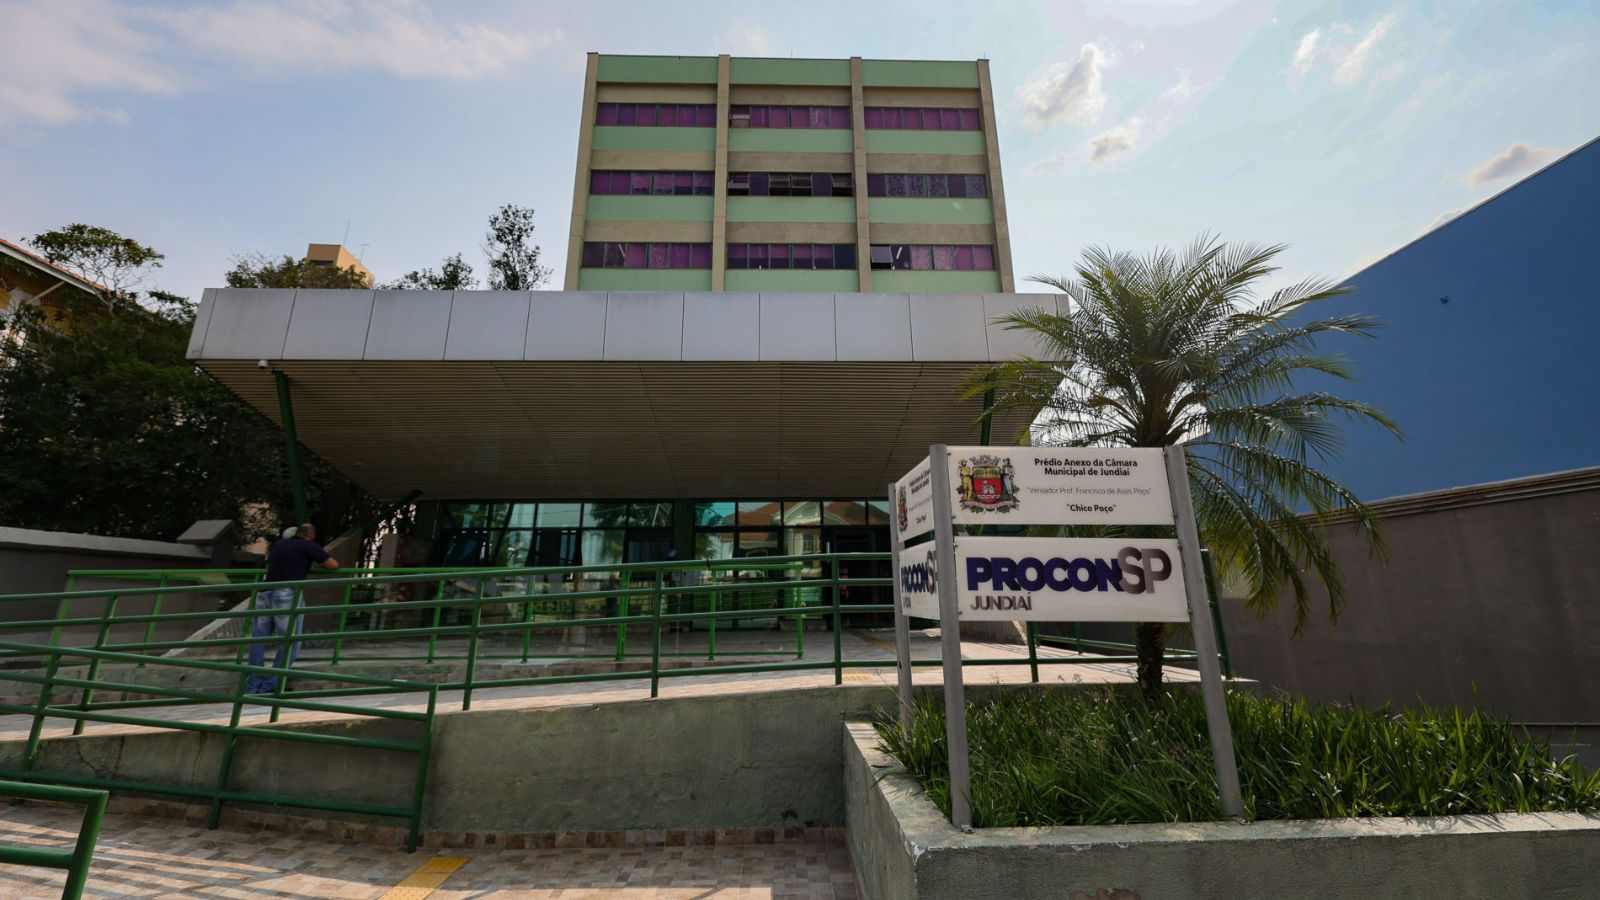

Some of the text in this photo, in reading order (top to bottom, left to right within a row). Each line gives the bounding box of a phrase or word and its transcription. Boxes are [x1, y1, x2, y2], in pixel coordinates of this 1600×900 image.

[1034, 458, 1138, 467] Prédio Anexo da Câmara
[1044, 467, 1086, 477] Municipal
[1088, 468, 1098, 476] de
[1066, 504, 1093, 512] "Chico
[971, 592, 1032, 610] JUNDIAÍ
